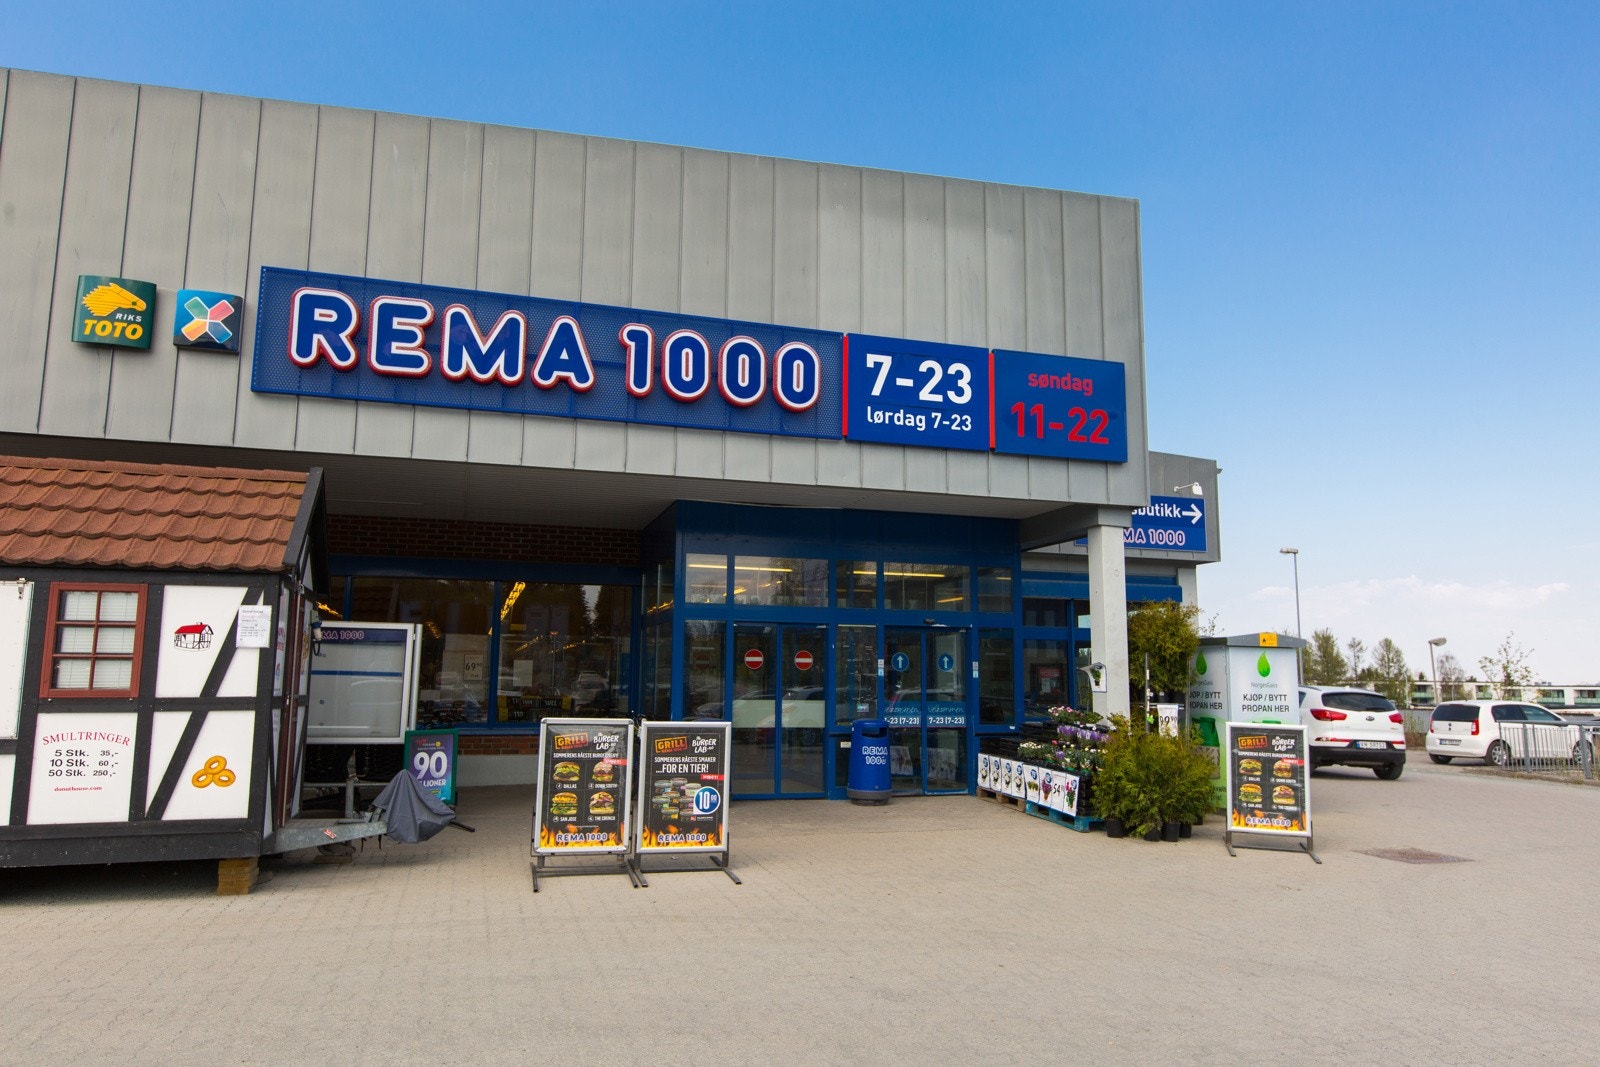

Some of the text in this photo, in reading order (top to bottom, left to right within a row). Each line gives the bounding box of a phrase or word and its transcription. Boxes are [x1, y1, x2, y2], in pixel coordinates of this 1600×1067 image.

[116, 313, 142, 322] RIKS
[84, 319, 143, 340] TOTO
[288, 287, 821, 412] REMA 1000
[866, 353, 972, 404] 7-23
[1028, 371, 1093, 396] søndag
[867, 406, 972, 432] lørdag 7-23
[1011, 402, 1109, 444] 11-22
[1148, 528, 1185, 546] 1000
[340, 631, 364, 640] 1000
[1243, 694, 1261, 702] KJØP
[1268, 694, 1287, 702] BYTT
[900, 716, 920, 724] (7-23)
[945, 716, 964, 724] (7-23)
[42, 732, 130, 746] SMULTRINGER
[556, 736, 586, 746] GRILL
[593, 735, 620, 744] BURGER
[692, 739, 716, 747] BURGER
[1240, 738, 1266, 747] GRILL
[657, 740, 686, 750] GRILL
[66, 749, 90, 757] Stk.
[862, 746, 888, 755] REMA
[50, 759, 62, 767] 10
[66, 759, 90, 767] Stk.
[414, 751, 448, 780] 90
[65, 769, 86, 777] Stk.
[678, 764, 688, 773] EN
[690, 764, 709, 773] TIER!
[423, 779, 447, 787] LIONER
[699, 791, 710, 809] 10
[1246, 817, 1291, 826] REMA 1000
[556, 832, 608, 842] REMA 1000
[658, 833, 707, 842] REMA 1000
